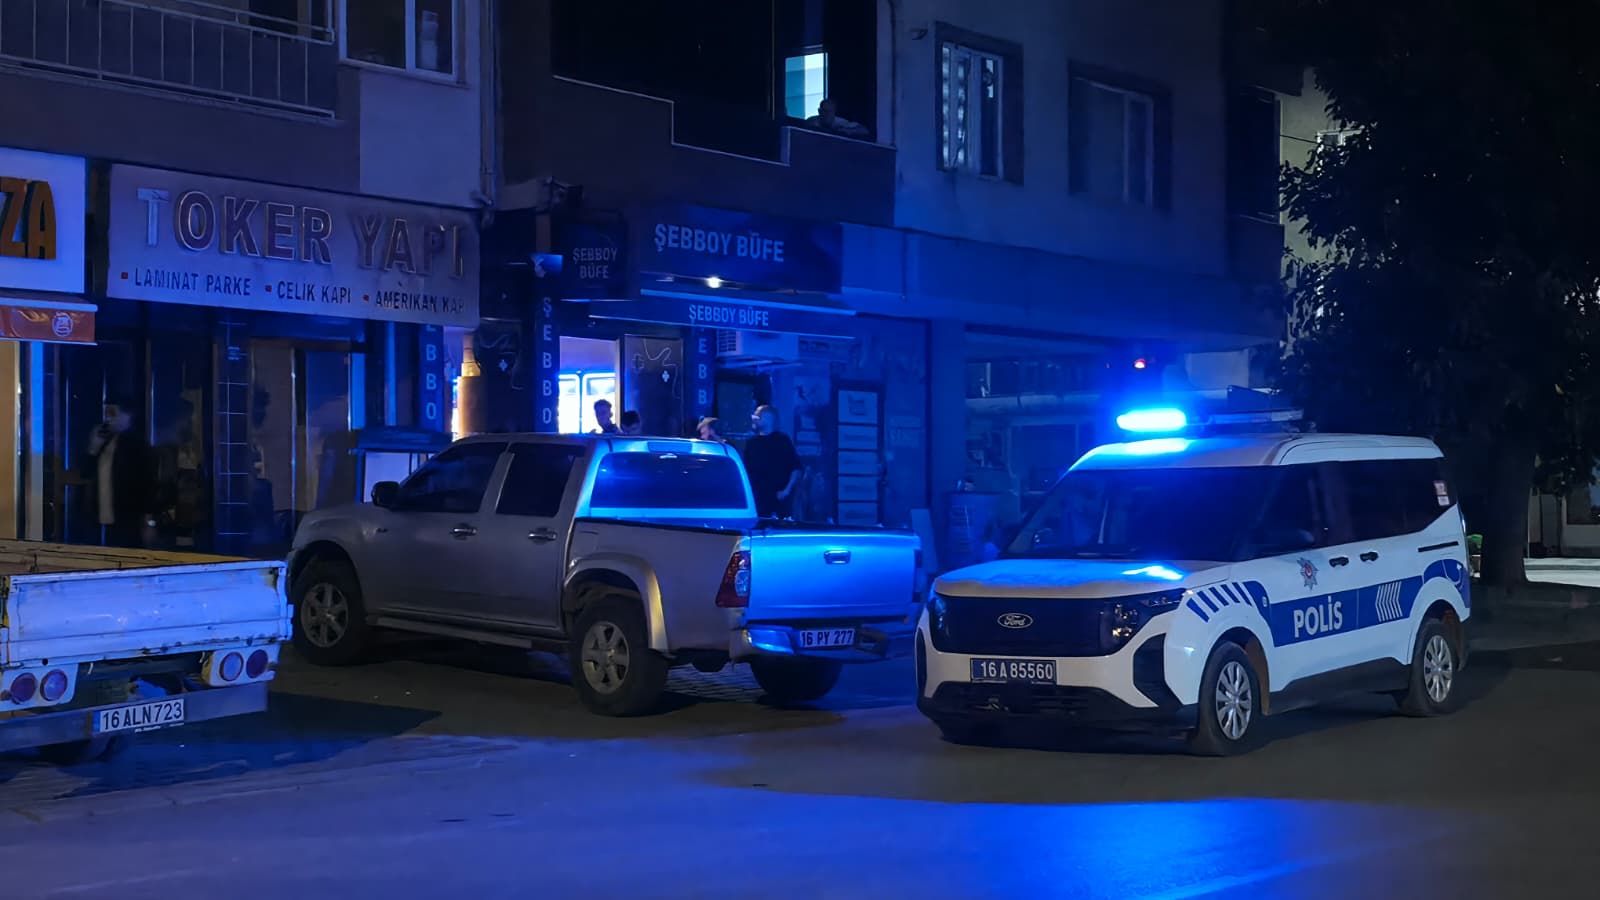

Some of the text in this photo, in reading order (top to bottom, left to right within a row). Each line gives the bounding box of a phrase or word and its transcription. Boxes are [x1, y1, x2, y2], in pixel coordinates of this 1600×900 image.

[137, 188, 464, 279] TOKER YAPI
[655, 223, 784, 262] ŞEBBOY BÜFE
[572, 247, 617, 264] ŞEBBOY
[580, 262, 609, 280] BÜFE
[135, 267, 199, 291] LAMINAT
[206, 274, 251, 296] PARKE
[321, 285, 351, 304] KAPI
[689, 304, 769, 326] ŞEBBOY BÜFE
[1004, 614, 1027, 627] Ford
[1293, 595, 1343, 638] POLİS
[801, 629, 854, 648] 16 PY 277
[980, 660, 1054, 680] 16 A 85560
[102, 710, 120, 731] 16
[123, 707, 151, 728] ALN
[154, 702, 183, 723] 723
